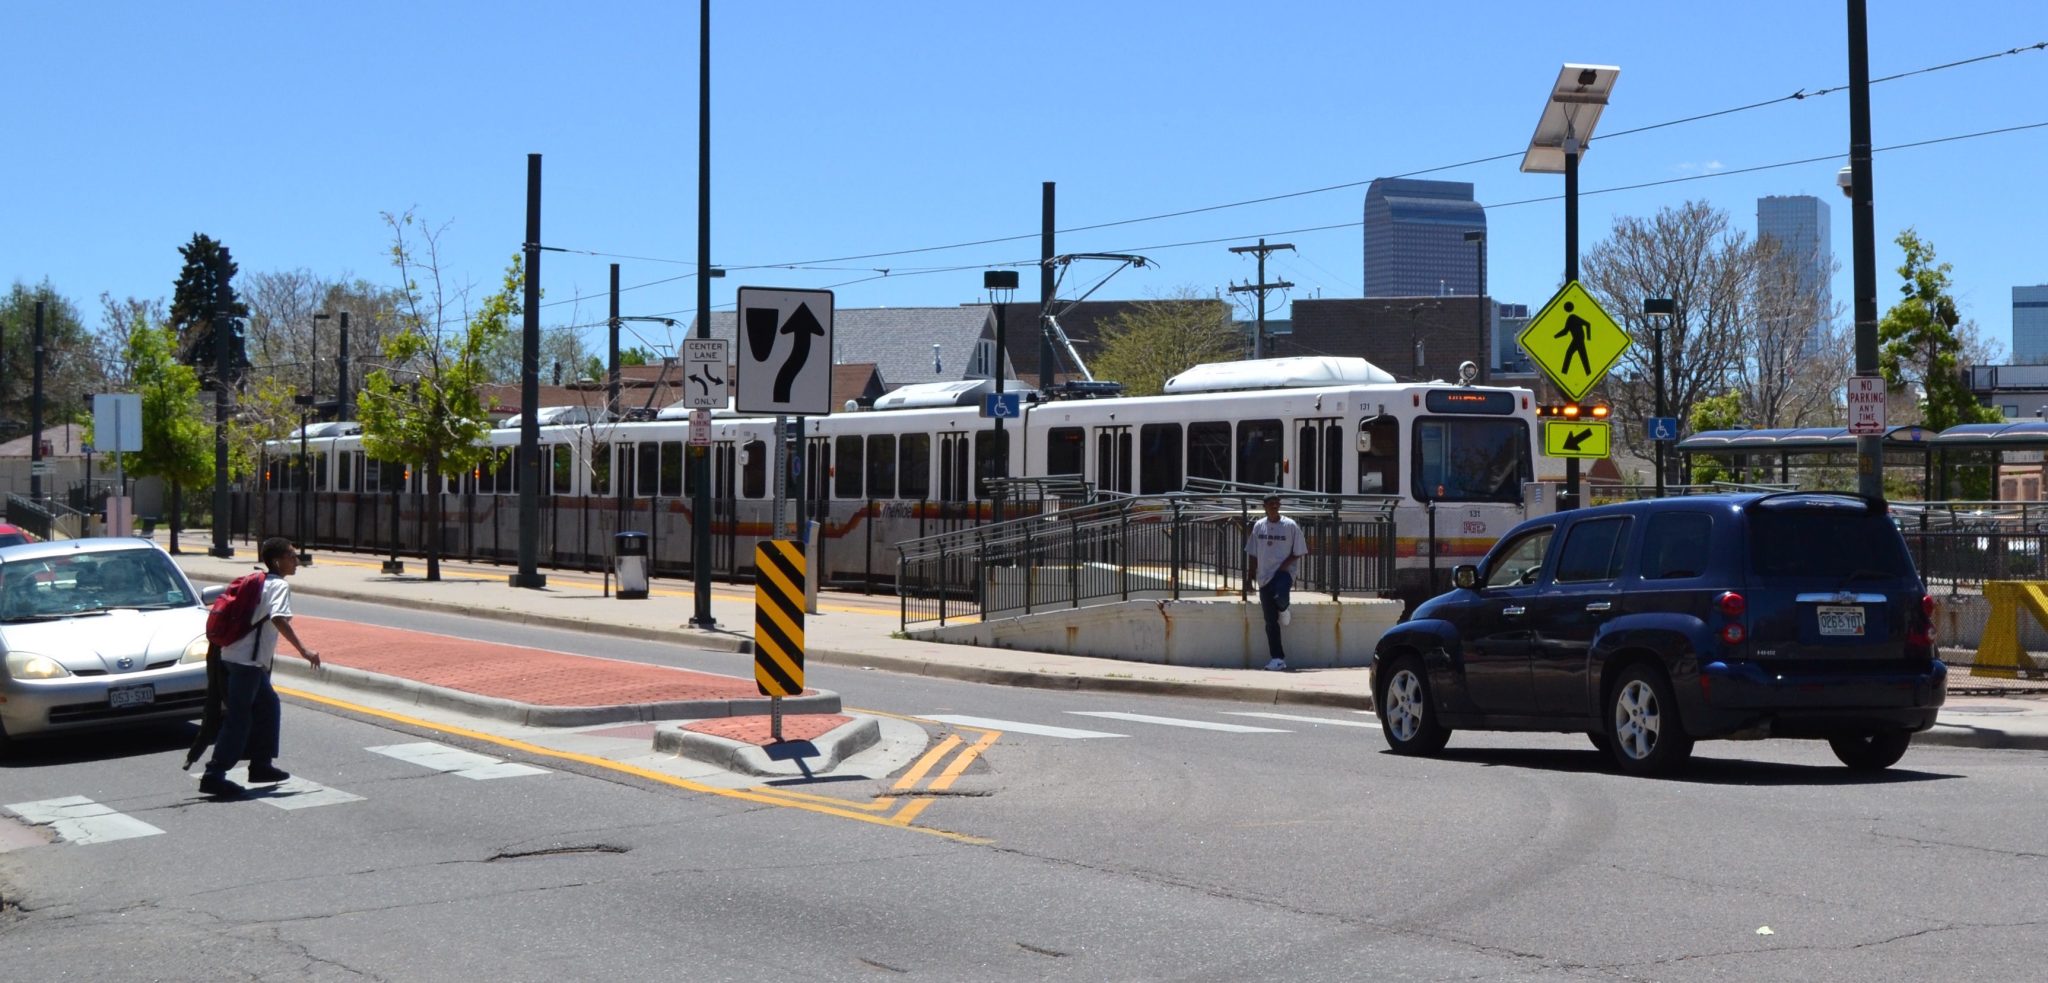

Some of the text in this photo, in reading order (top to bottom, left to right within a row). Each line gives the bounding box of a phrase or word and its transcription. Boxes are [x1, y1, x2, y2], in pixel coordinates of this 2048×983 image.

[1861, 380, 1873, 391] NO
[1850, 392, 1884, 403] PARKING
[1360, 403, 1370, 411] 131
[1859, 413, 1876, 421] TIME
[1469, 510, 1481, 518] 131
[1463, 521, 1486, 534] RTD
